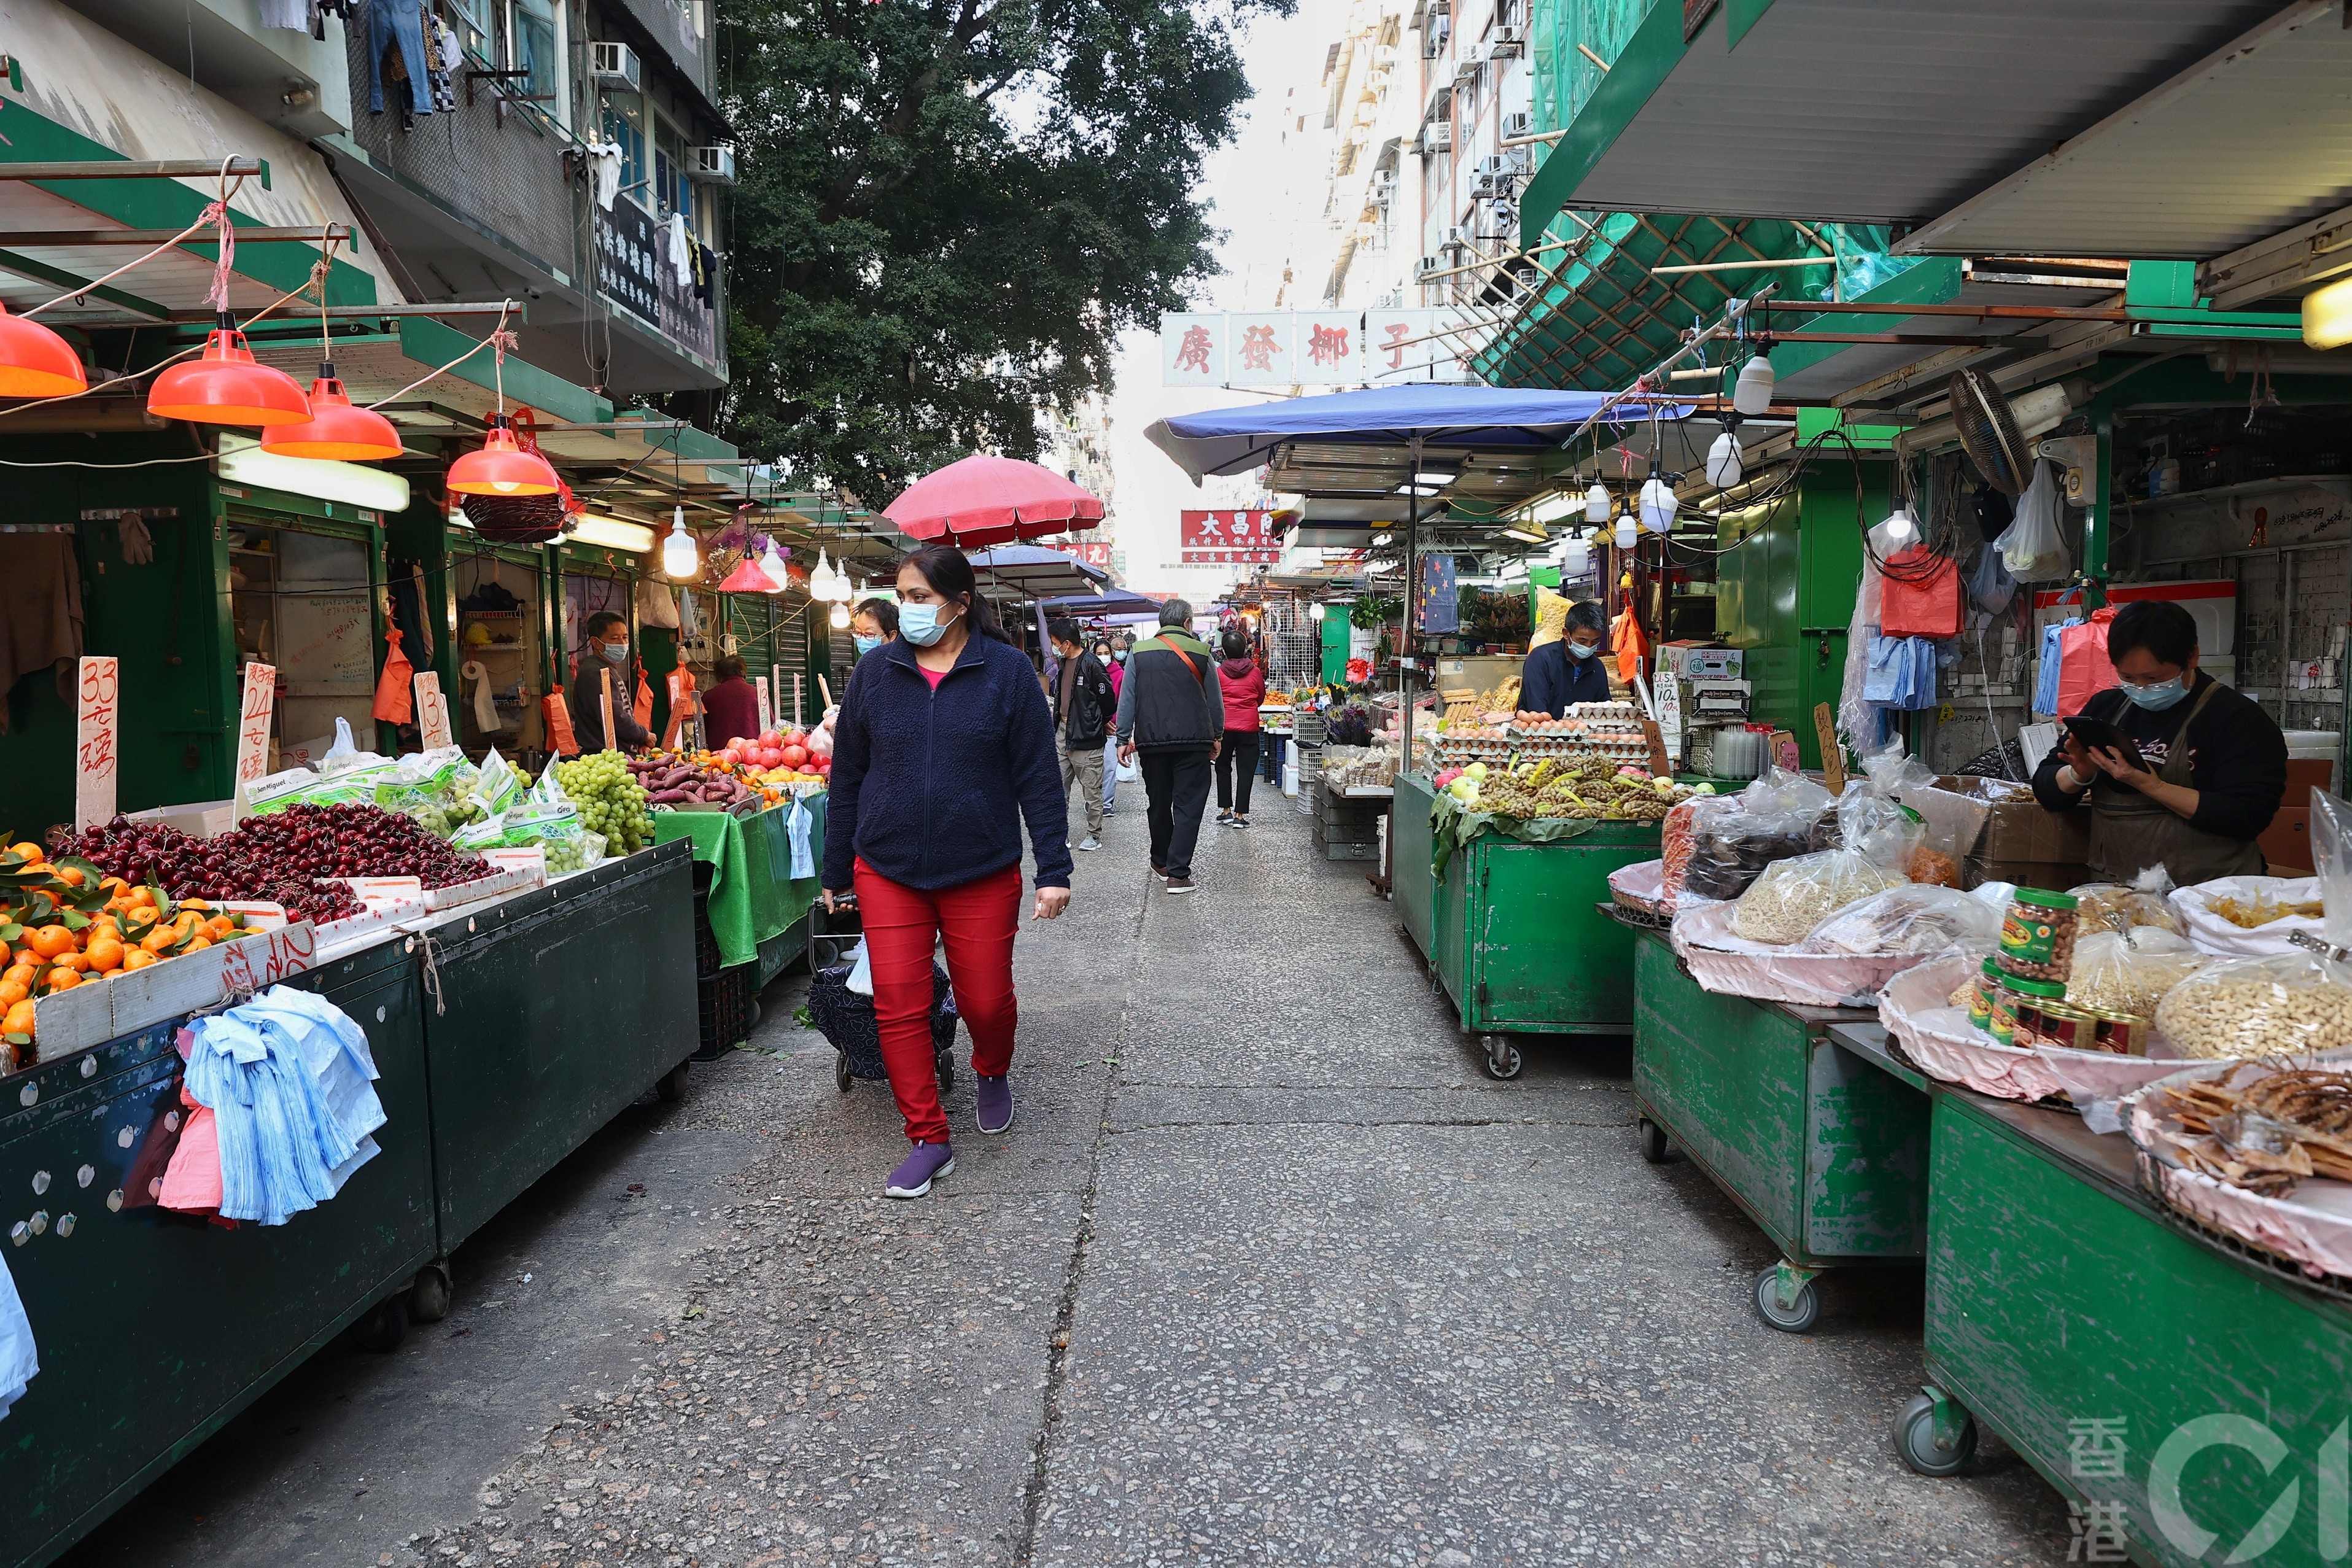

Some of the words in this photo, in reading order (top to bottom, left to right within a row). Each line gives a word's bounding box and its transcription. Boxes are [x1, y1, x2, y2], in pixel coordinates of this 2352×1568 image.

[1173, 323, 1417, 373] 廣發椰子
[1190, 552, 1270, 562] 大昌隆紙號
[1692, 661, 1702, 671] 福
[266, 779, 285, 790] Miguel
[477, 825, 497, 834] Miguel
